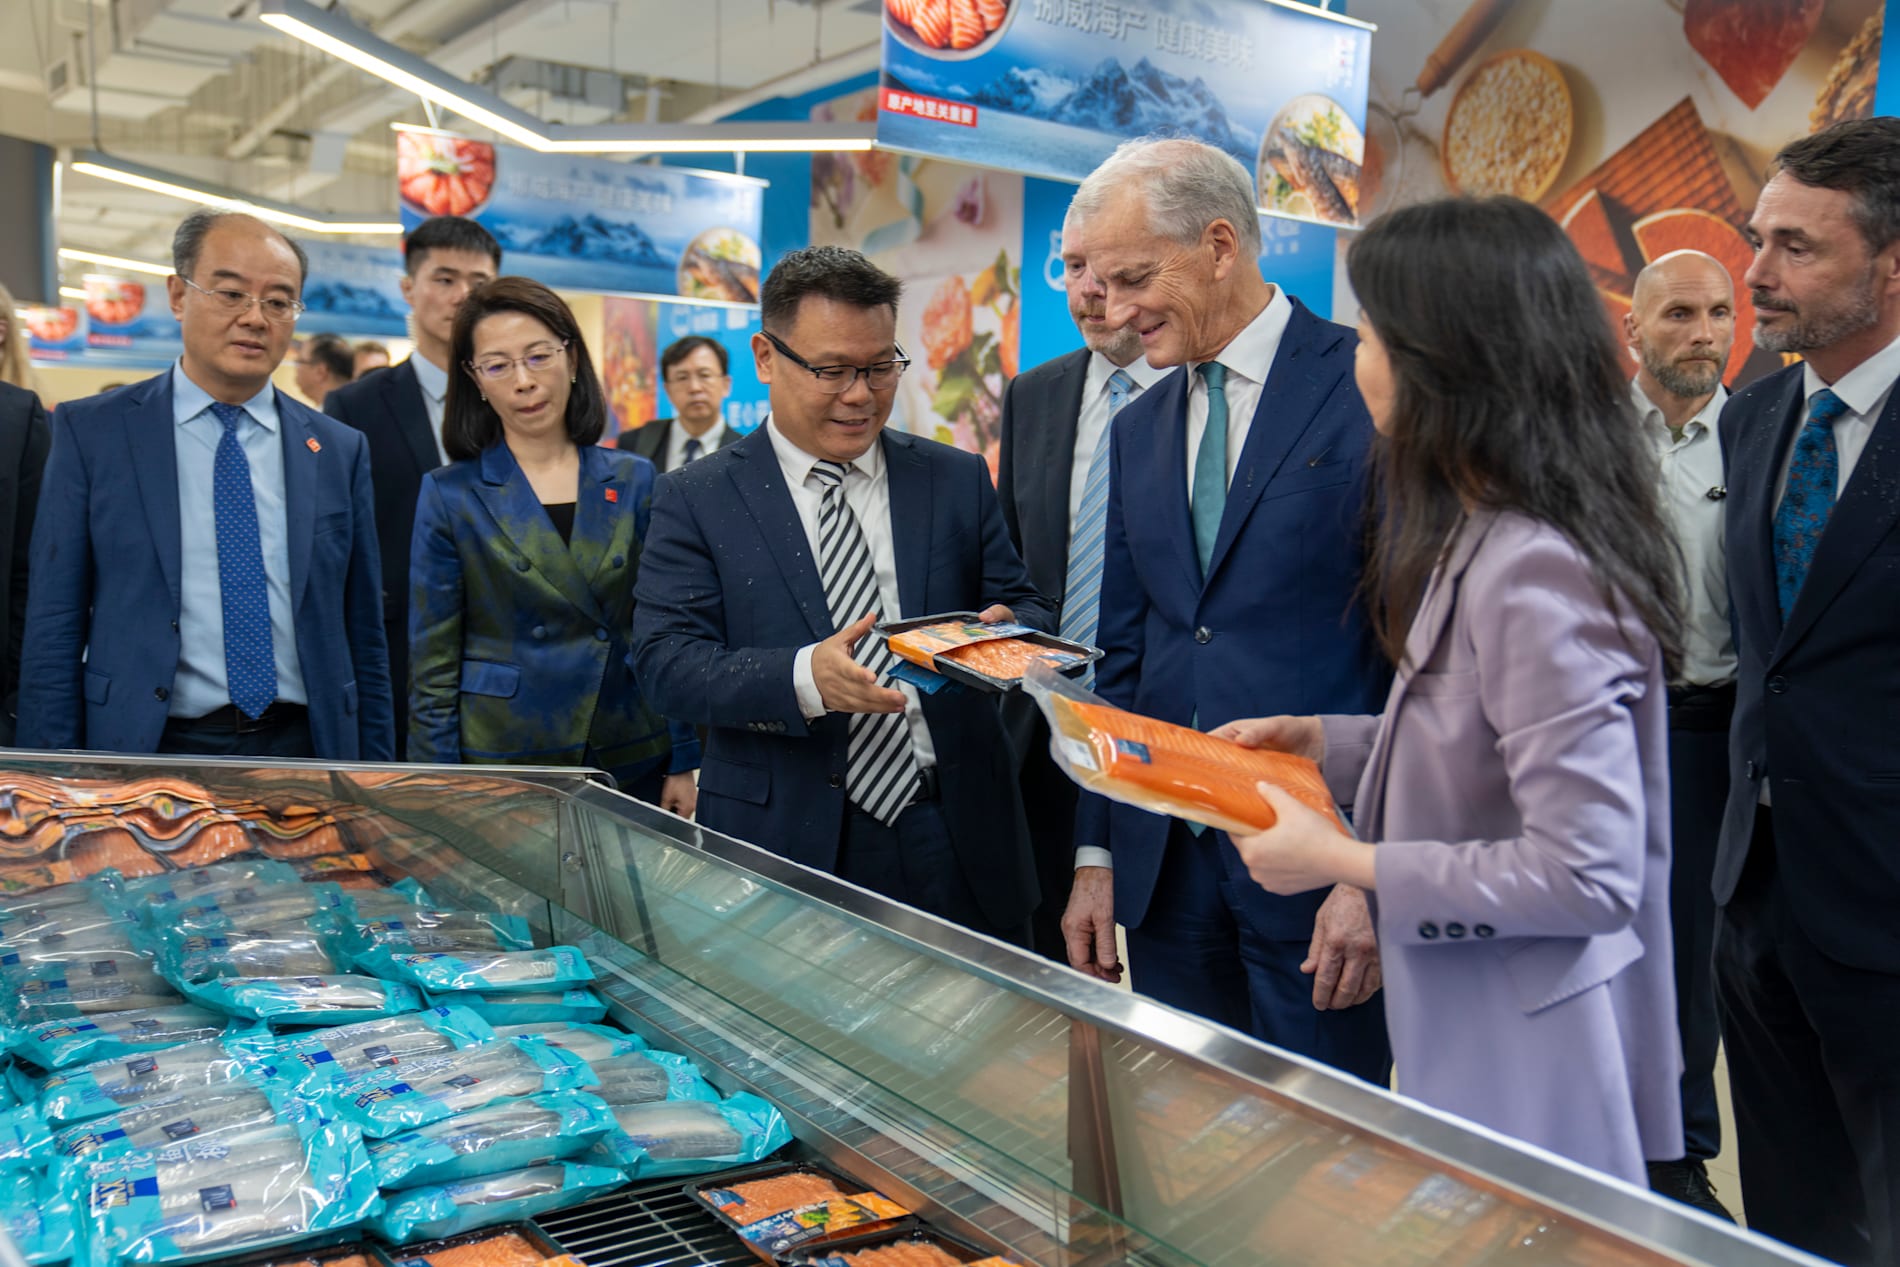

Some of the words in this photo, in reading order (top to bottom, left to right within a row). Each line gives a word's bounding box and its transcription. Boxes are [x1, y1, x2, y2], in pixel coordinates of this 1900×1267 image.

[887, 92, 974, 125] 原产地至关重要
